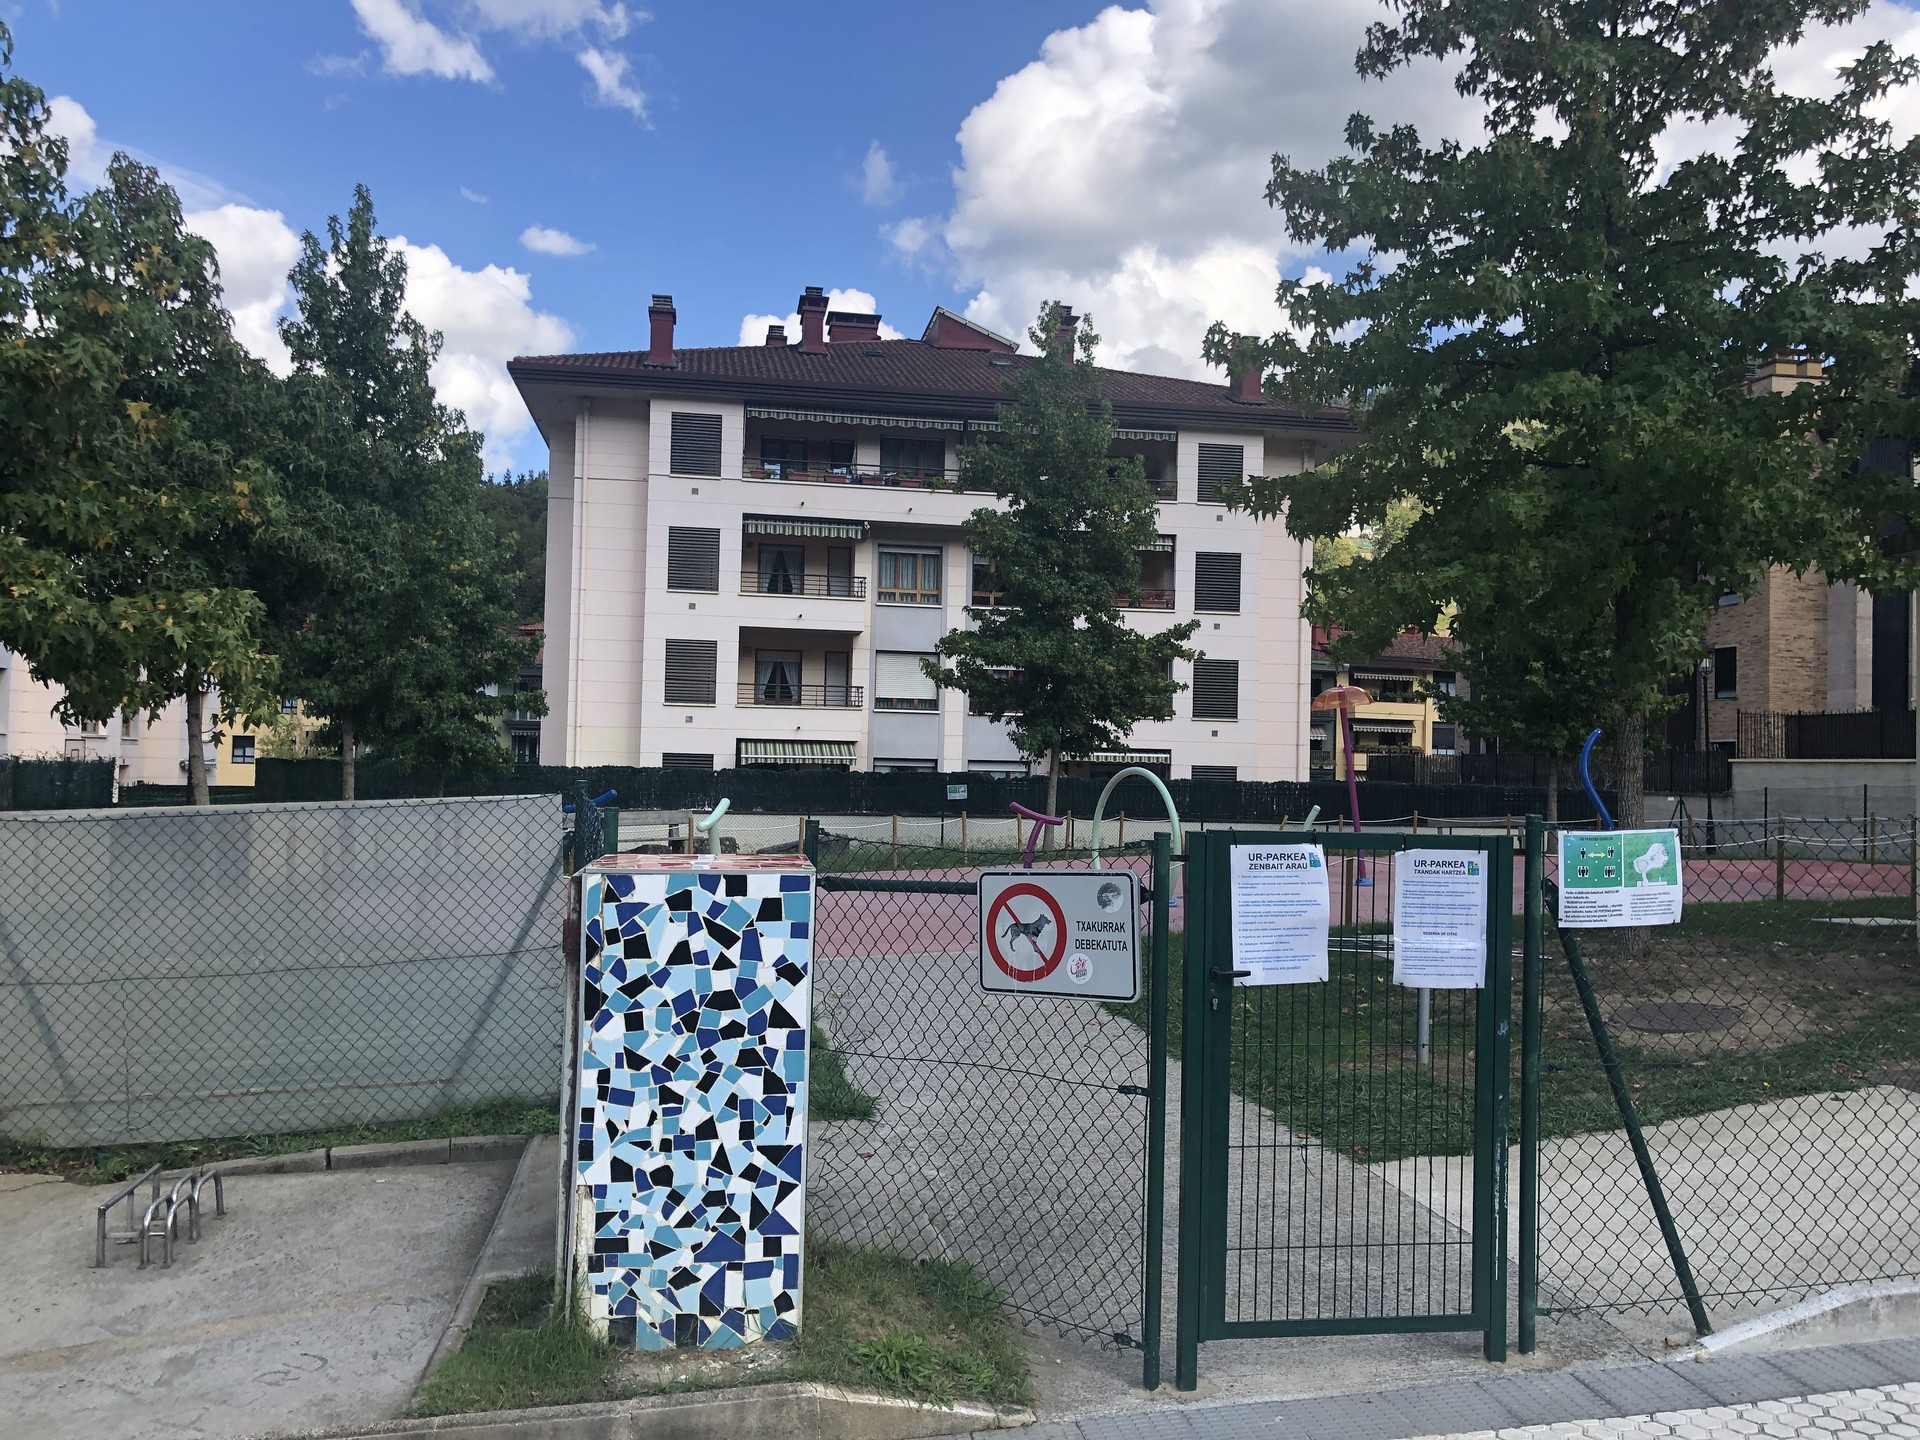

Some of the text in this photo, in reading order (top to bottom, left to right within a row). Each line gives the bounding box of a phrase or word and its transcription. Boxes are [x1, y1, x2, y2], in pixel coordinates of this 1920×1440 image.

[1248, 852, 1307, 861] UR-PARKEA
[1248, 862, 1308, 871] ZENBAIT ARAU
[1414, 859, 1466, 869] UR-PARKEA
[1076, 920, 1126, 933] TXAKURRAK
[1074, 938, 1128, 952] DEBEKATUTA
